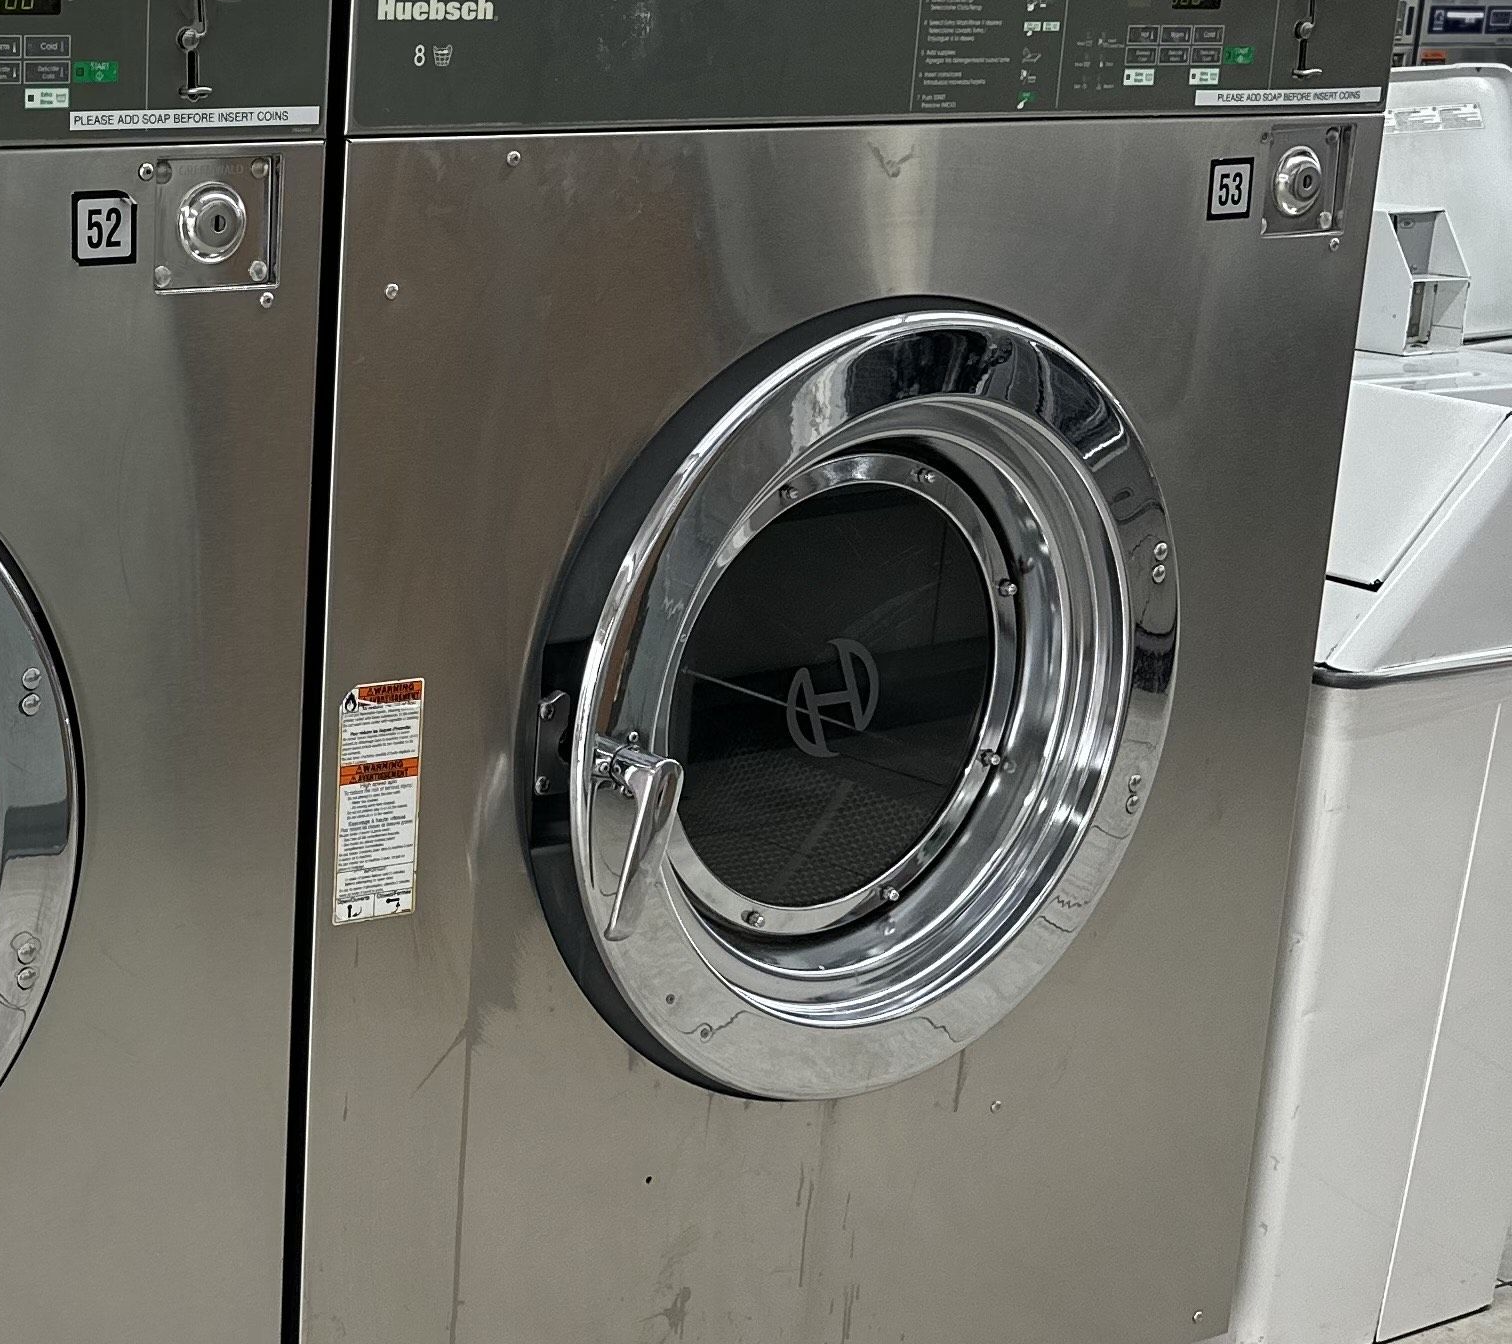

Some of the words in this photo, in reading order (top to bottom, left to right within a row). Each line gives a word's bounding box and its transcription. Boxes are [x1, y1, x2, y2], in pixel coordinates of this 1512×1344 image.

[414, 44, 425, 67] 8
[1217, 93, 1244, 102] PLEASE
[1246, 93, 1261, 102] ADD
[1263, 93, 1282, 102] SOAP
[1284, 92, 1311, 101] BEFORE
[1313, 91, 1337, 100] INSERT
[1339, 91, 1360, 99] COINS
[74, 115, 114, 126] PLEASE
[118, 114, 139, 125] ADD
[142, 114, 170, 124] SOAP
[174, 113, 215, 124] BEFORE
[218, 112, 254, 122] INSERT
[257, 111, 288, 122] COINS
[1218, 172, 1243, 207] 53
[87, 208, 122, 249] 52
